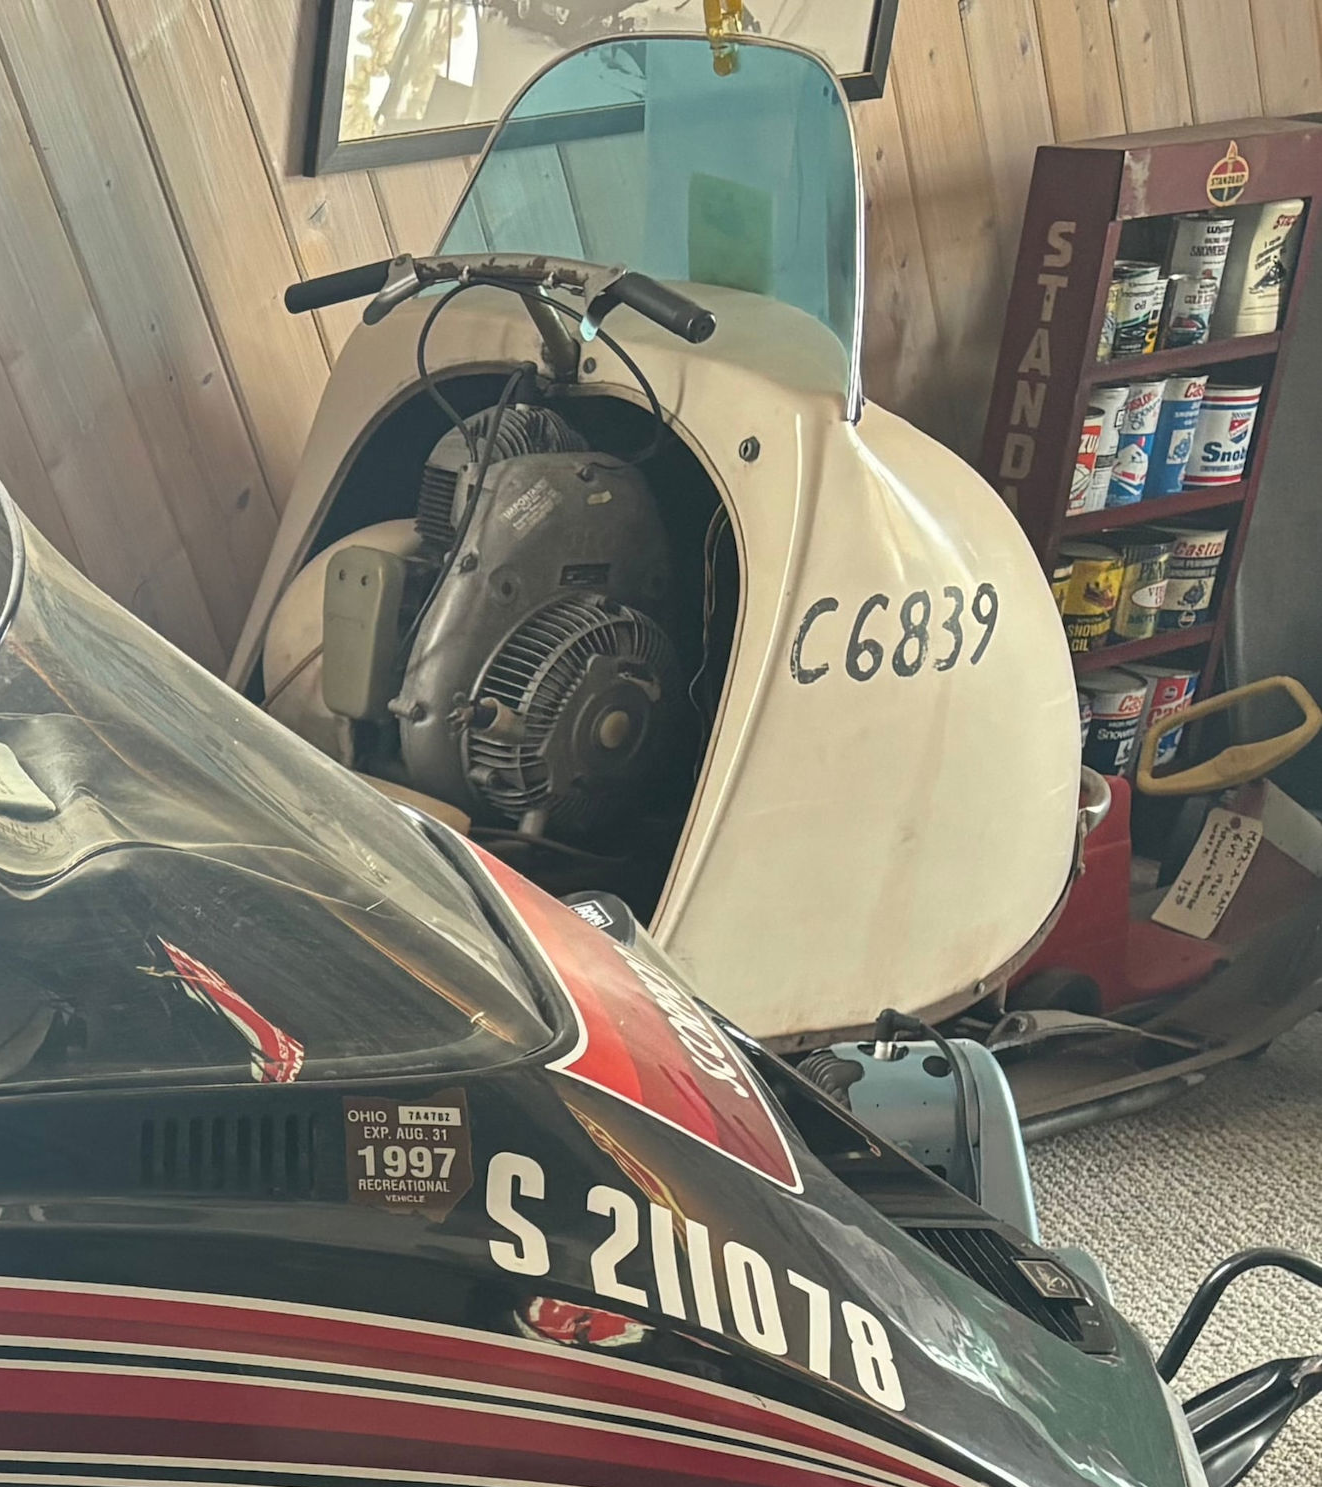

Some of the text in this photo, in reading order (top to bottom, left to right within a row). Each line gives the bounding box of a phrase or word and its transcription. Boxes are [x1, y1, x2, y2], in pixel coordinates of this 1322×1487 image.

[790, 582, 999, 685] C6839
[348, 1110, 387, 1123] OHIO
[364, 1126, 447, 1141] EXP. AUG. 31
[358, 1145, 456, 1178] 1997
[358, 1179, 450, 1193] RECREATIONAL
[385, 1194, 426, 1203] VEHICLE
[486, 1151, 550, 1277] S
